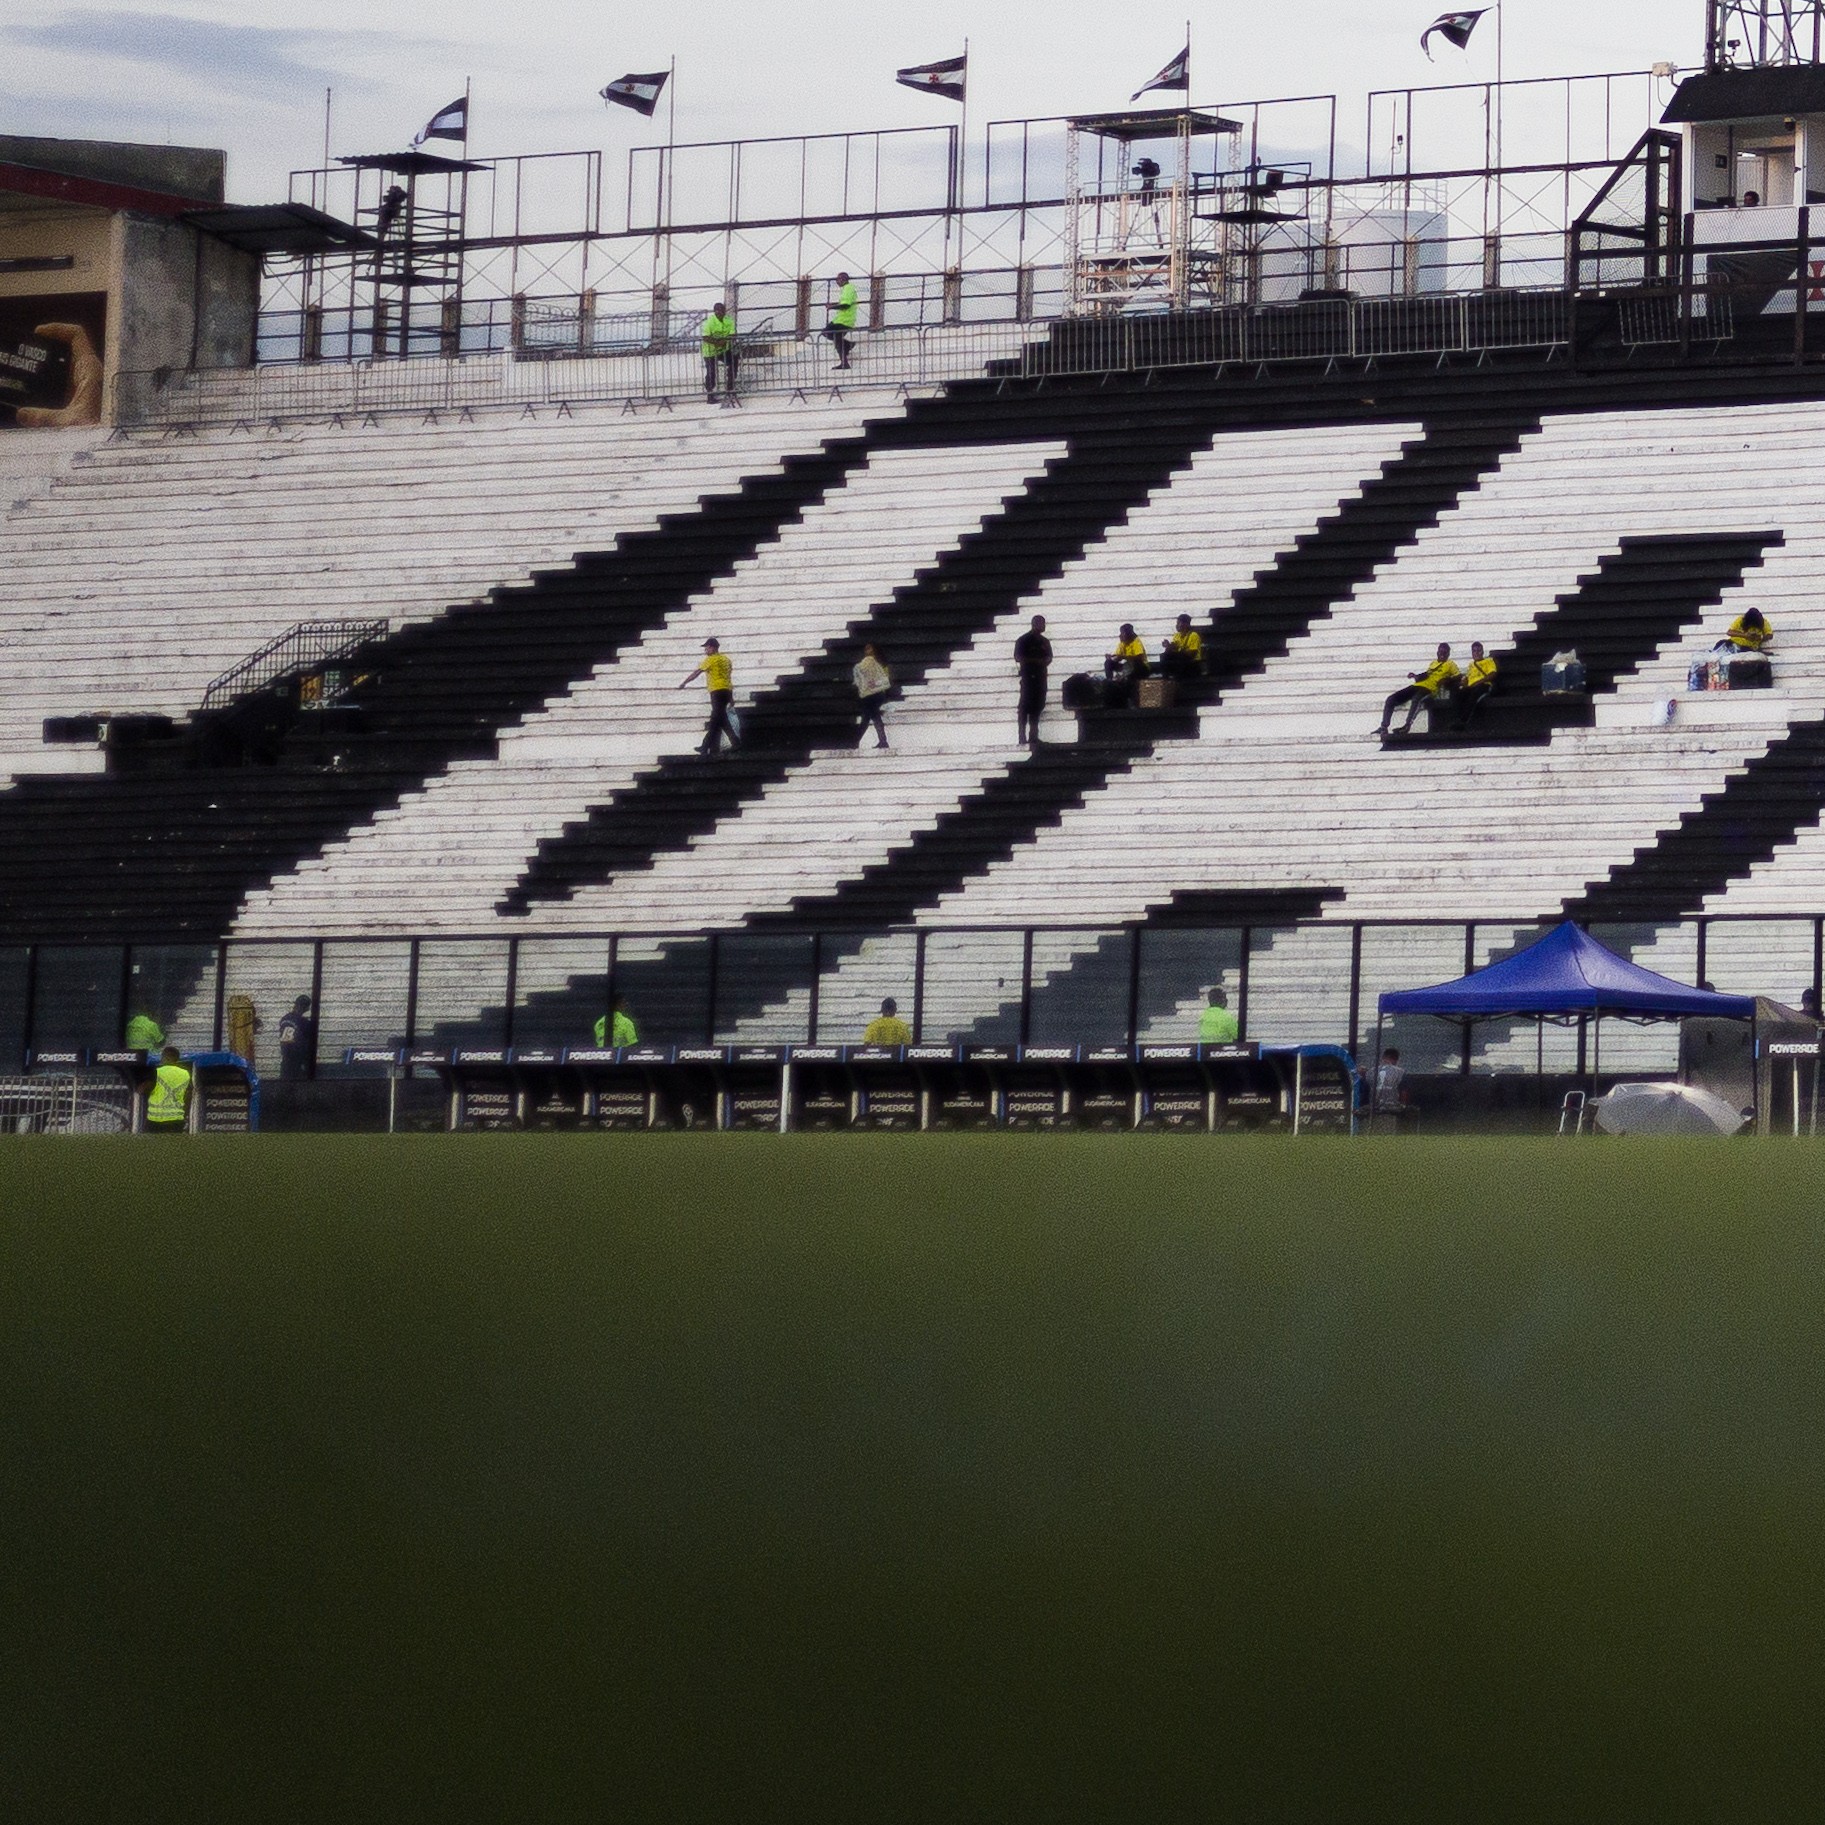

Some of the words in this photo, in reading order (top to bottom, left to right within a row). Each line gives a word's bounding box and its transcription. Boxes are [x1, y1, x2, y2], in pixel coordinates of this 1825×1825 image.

[1144, 1048, 1191, 1058] POWERADE
[1769, 1044, 1820, 1053] POWERADE
[460, 1052, 502, 1061] POWERADE
[569, 1051, 612, 1061] POWERADE
[680, 1050, 722, 1059] POWERADE
[792, 1049, 837, 1059] POWERADE
[908, 1049, 952, 1058] POWERADE
[1025, 1049, 1071, 1058] POWERADE
